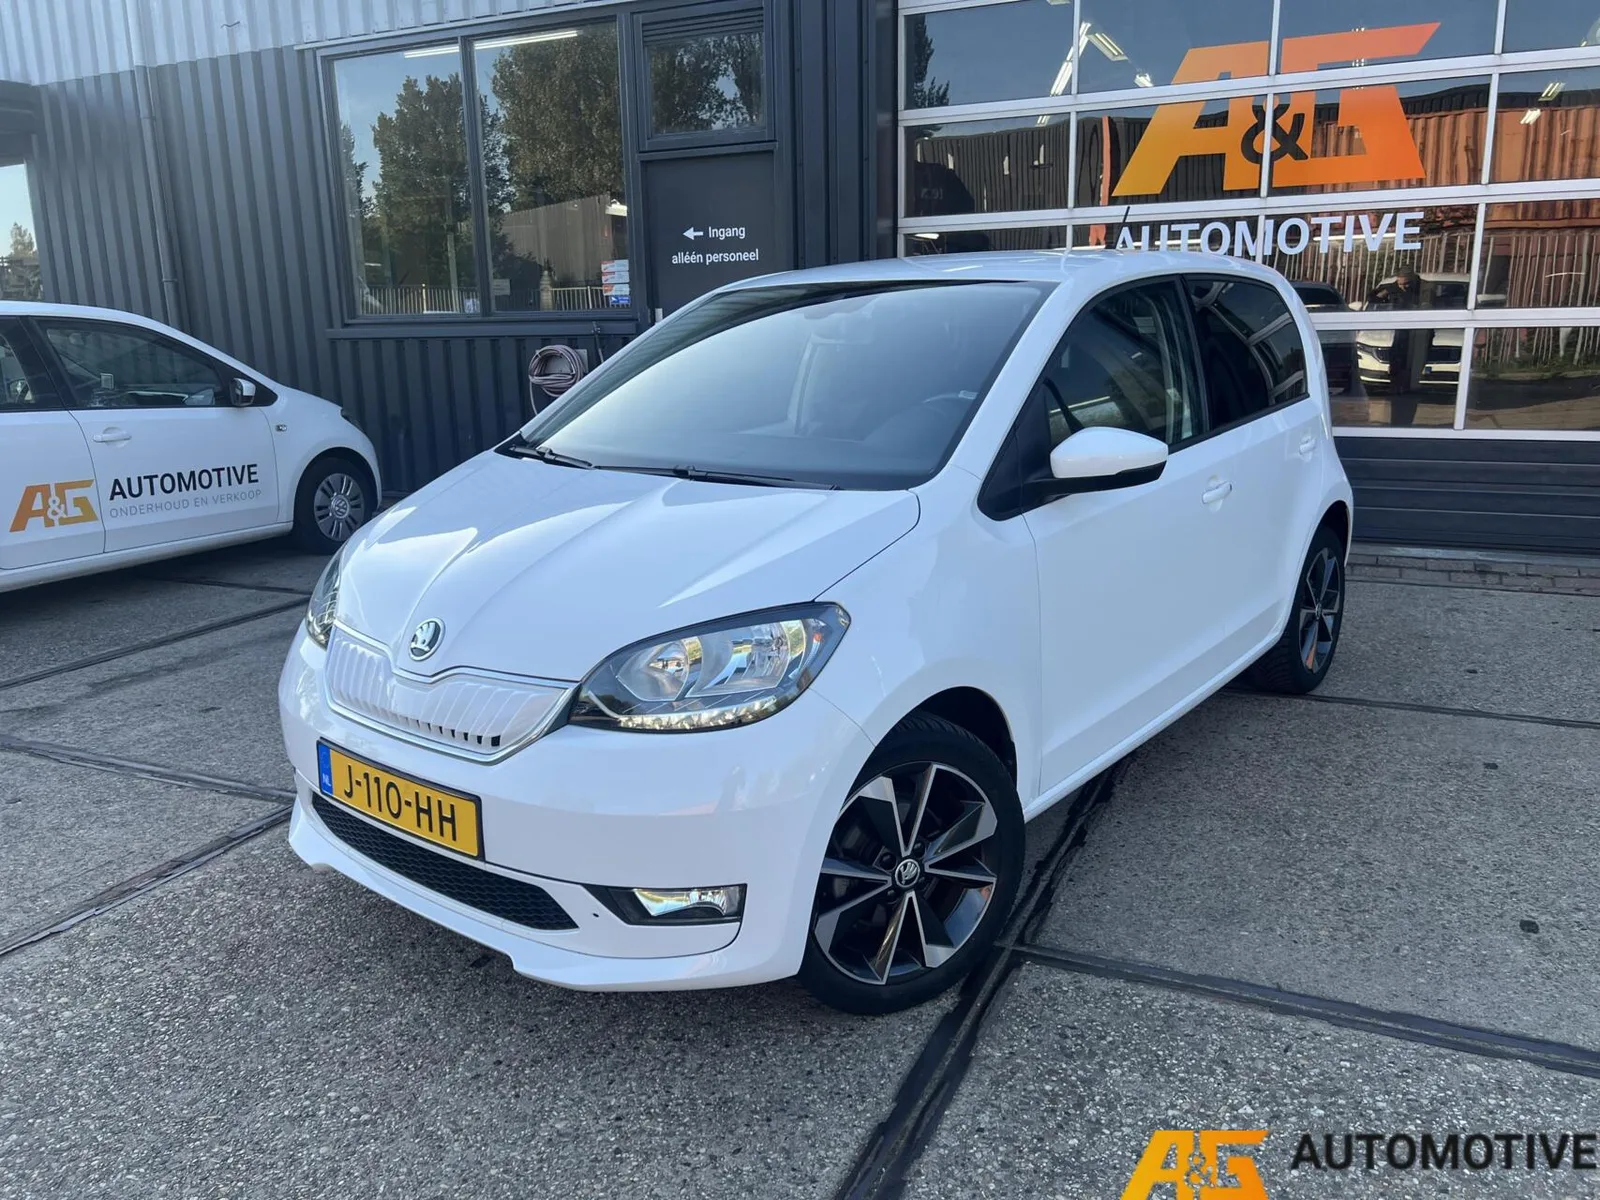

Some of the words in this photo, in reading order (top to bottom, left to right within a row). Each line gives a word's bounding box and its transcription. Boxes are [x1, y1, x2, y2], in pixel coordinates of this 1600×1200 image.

[1112, 22, 1441, 197] A&G
[708, 226, 746, 241] Ingang
[1115, 211, 1424, 256] AUTOMOTIVE
[671, 251, 703, 265] alléén
[705, 248, 759, 265] personeel
[109, 463, 259, 501] AUTOMOTIVE
[9, 479, 98, 533] A&G
[109, 498, 190, 519] ONDERHOUD
[194, 496, 209, 508] EN
[211, 489, 262, 505] VERKOOP
[322, 773, 332, 787] NL
[344, 764, 457, 842] J-110-HH
